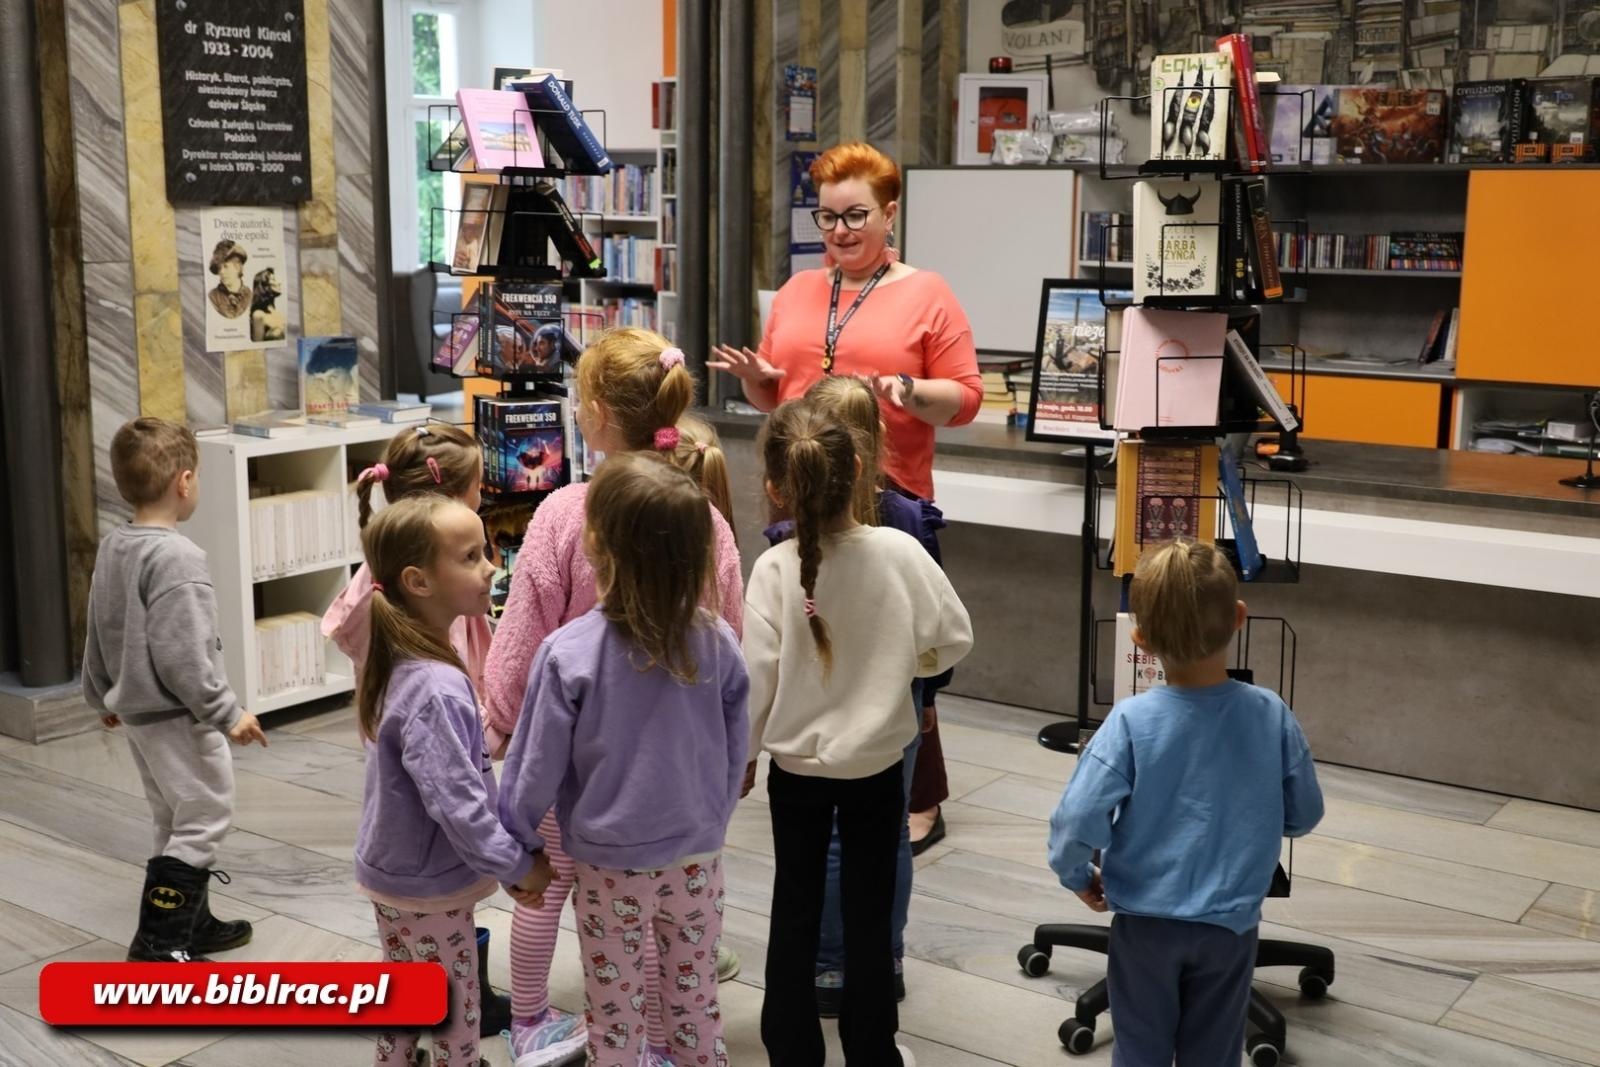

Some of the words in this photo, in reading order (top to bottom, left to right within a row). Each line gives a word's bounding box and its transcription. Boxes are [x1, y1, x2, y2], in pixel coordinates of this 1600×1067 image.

[184, 20, 198, 35] dr
[205, 22, 251, 39] Ryszard
[258, 26, 292, 43] Kincel
[203, 40, 231, 56] 1933
[241, 44, 273, 59] 2004
[185, 69, 222, 83] Historyk,
[1456, 84, 1506, 96] CIVILIZATION
[547, 80, 571, 112] DONALD
[567, 109, 583, 130] TUSK
[187, 118, 220, 129] Członek
[223, 132, 257, 143] Polskich
[182, 148, 218, 161] Dyrektor
[199, 163, 208, 172] w
[236, 162, 255, 173] 1979
[261, 163, 285, 173] 2000
[213, 217, 239, 230] Dwie
[240, 217, 275, 230] autorki,
[220, 230, 244, 241] dwie
[244, 230, 270, 244] epoki
[544, 295, 558, 305] 350
[1127, 653, 1157, 665] SEBIE
